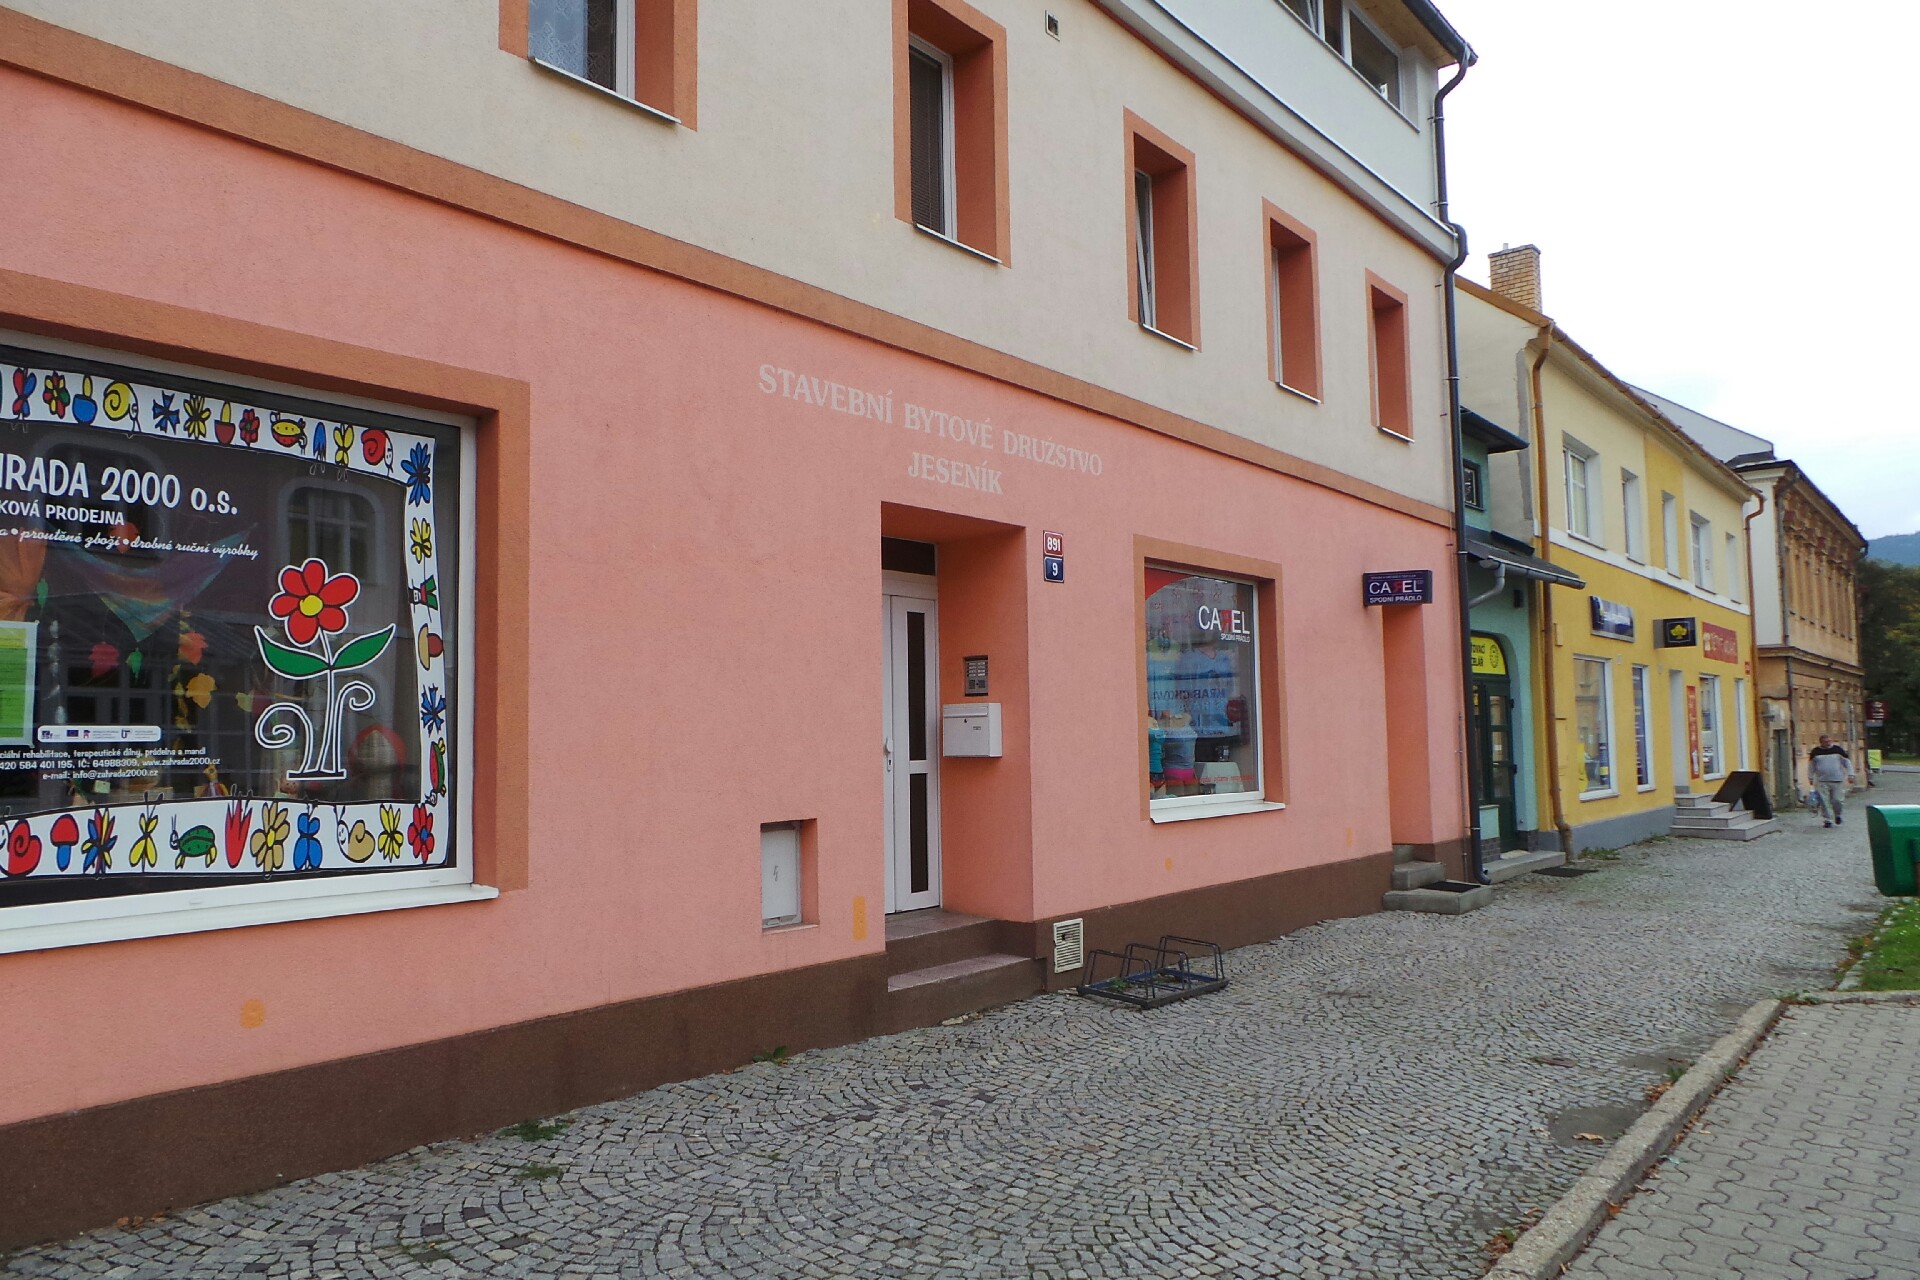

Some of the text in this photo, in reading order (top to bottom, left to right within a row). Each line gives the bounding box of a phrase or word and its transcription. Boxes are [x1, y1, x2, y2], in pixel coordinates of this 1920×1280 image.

[758, 364, 1103, 476] STAVEBNÍ BYTOVÉ DRUŽSTVO
[908, 452, 1004, 495] JESENÍK
[101, 466, 181, 508] 2000
[190, 487, 238, 515] o.s.
[45, 504, 125, 526] PRODEJNA
[19, 529, 82, 542] proutěné
[84, 532, 120, 550] zboží
[130, 536, 173, 551] drobné
[175, 542, 210, 553] ruční
[212, 543, 259, 560] výrobky
[1047, 536, 1061, 552] 891
[1052, 562, 1059, 577] 9
[73, 747, 121, 759] terapeutické
[19, 761, 37, 770] 584
[39, 761, 55, 769] 401
[142, 757, 220, 766] www.zahrada2000.cz
[42, 769, 159, 780] e-mail: info@zahrada2000.cz
